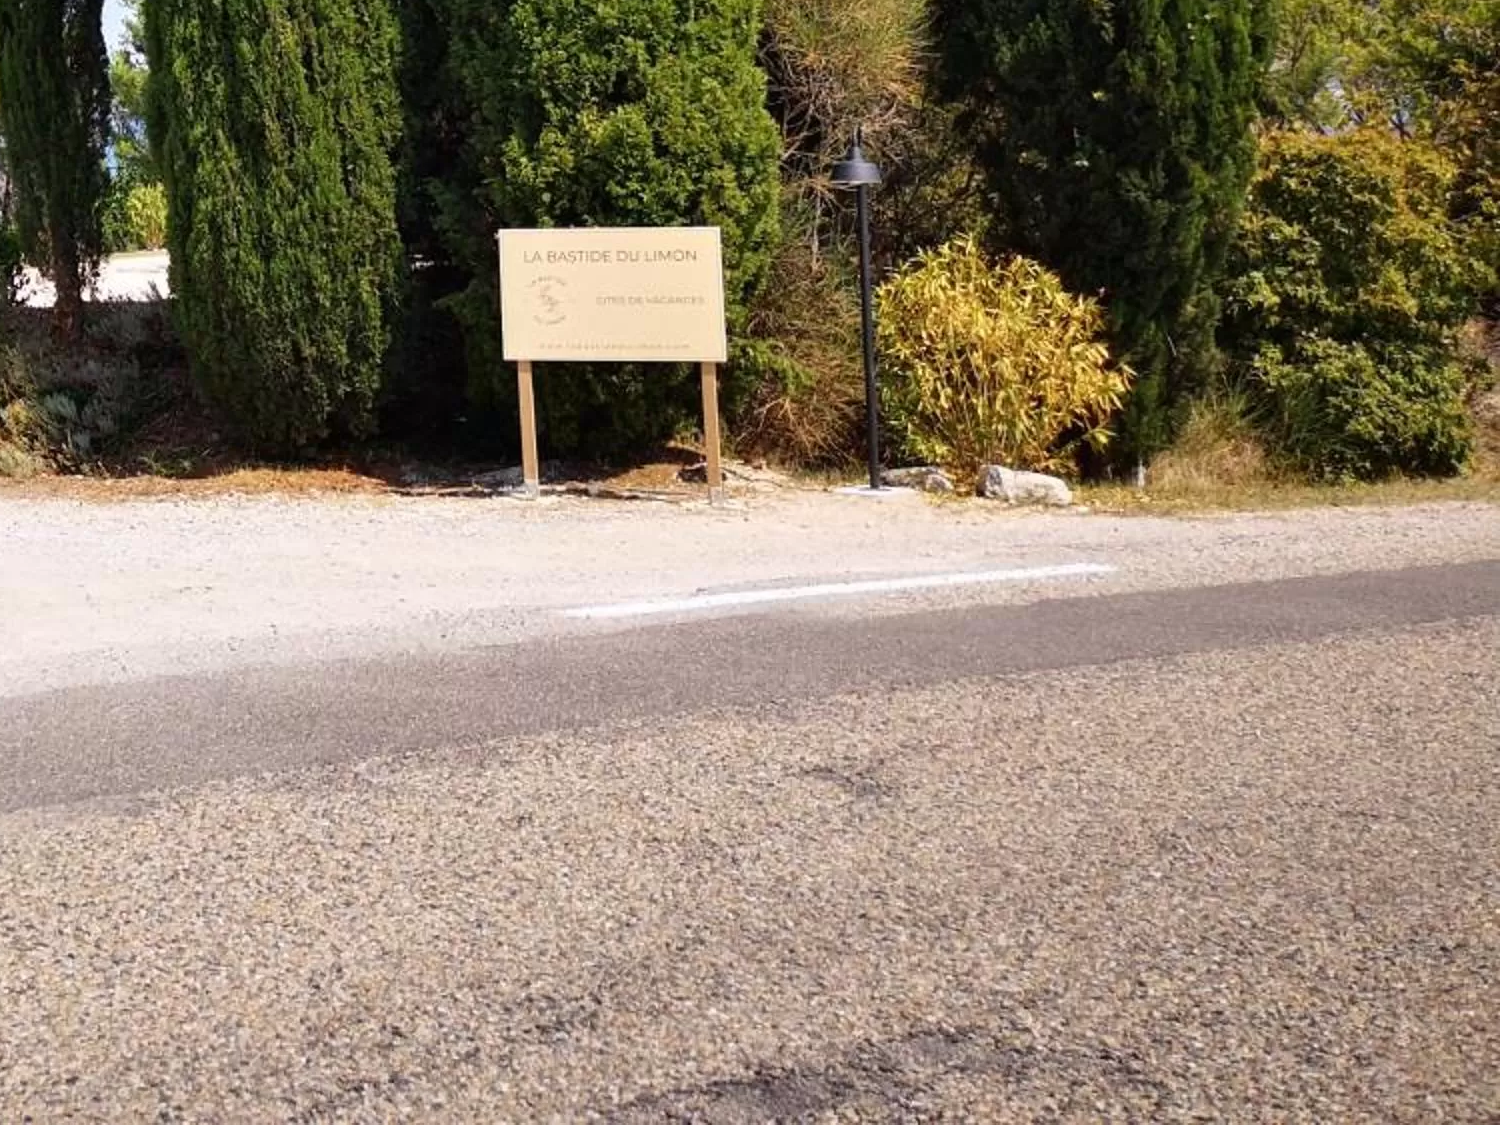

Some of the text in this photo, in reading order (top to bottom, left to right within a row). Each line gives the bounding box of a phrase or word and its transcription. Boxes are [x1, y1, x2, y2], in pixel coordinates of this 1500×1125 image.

[523, 249, 698, 264] LA BASTIDE DU LIMON
